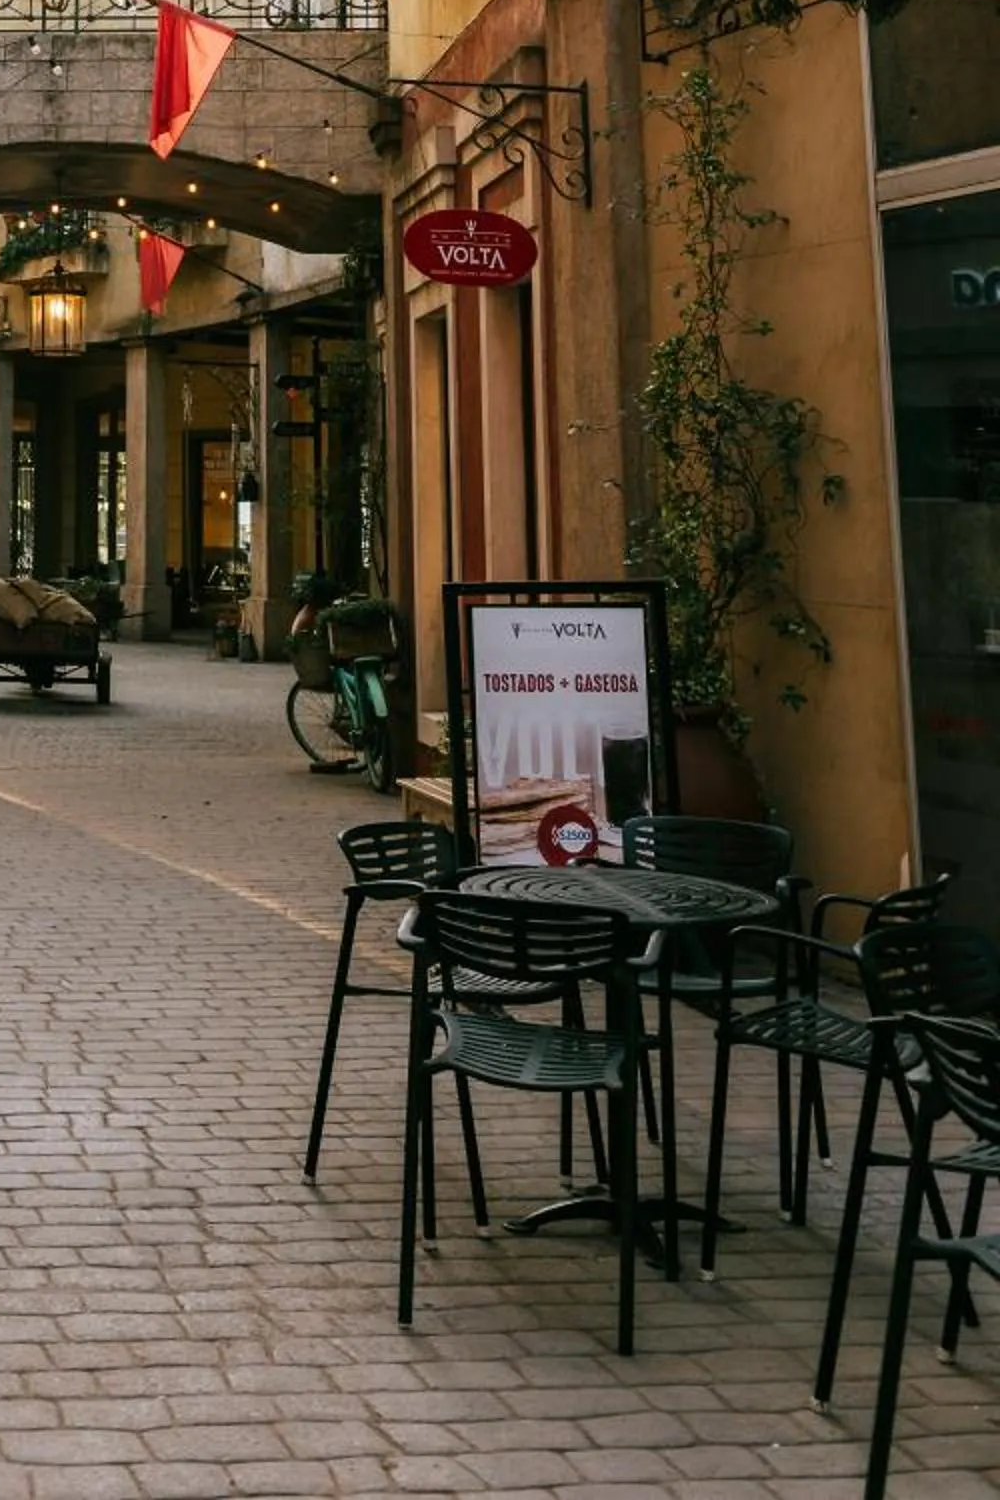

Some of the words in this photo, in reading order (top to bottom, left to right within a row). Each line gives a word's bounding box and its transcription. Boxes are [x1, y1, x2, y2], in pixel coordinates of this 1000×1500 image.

[436, 245, 506, 271] VOLTA
[551, 621, 607, 640] VOLTA
[483, 673, 556, 693] TOSTADOS
[575, 673, 639, 693] GASEOSA
